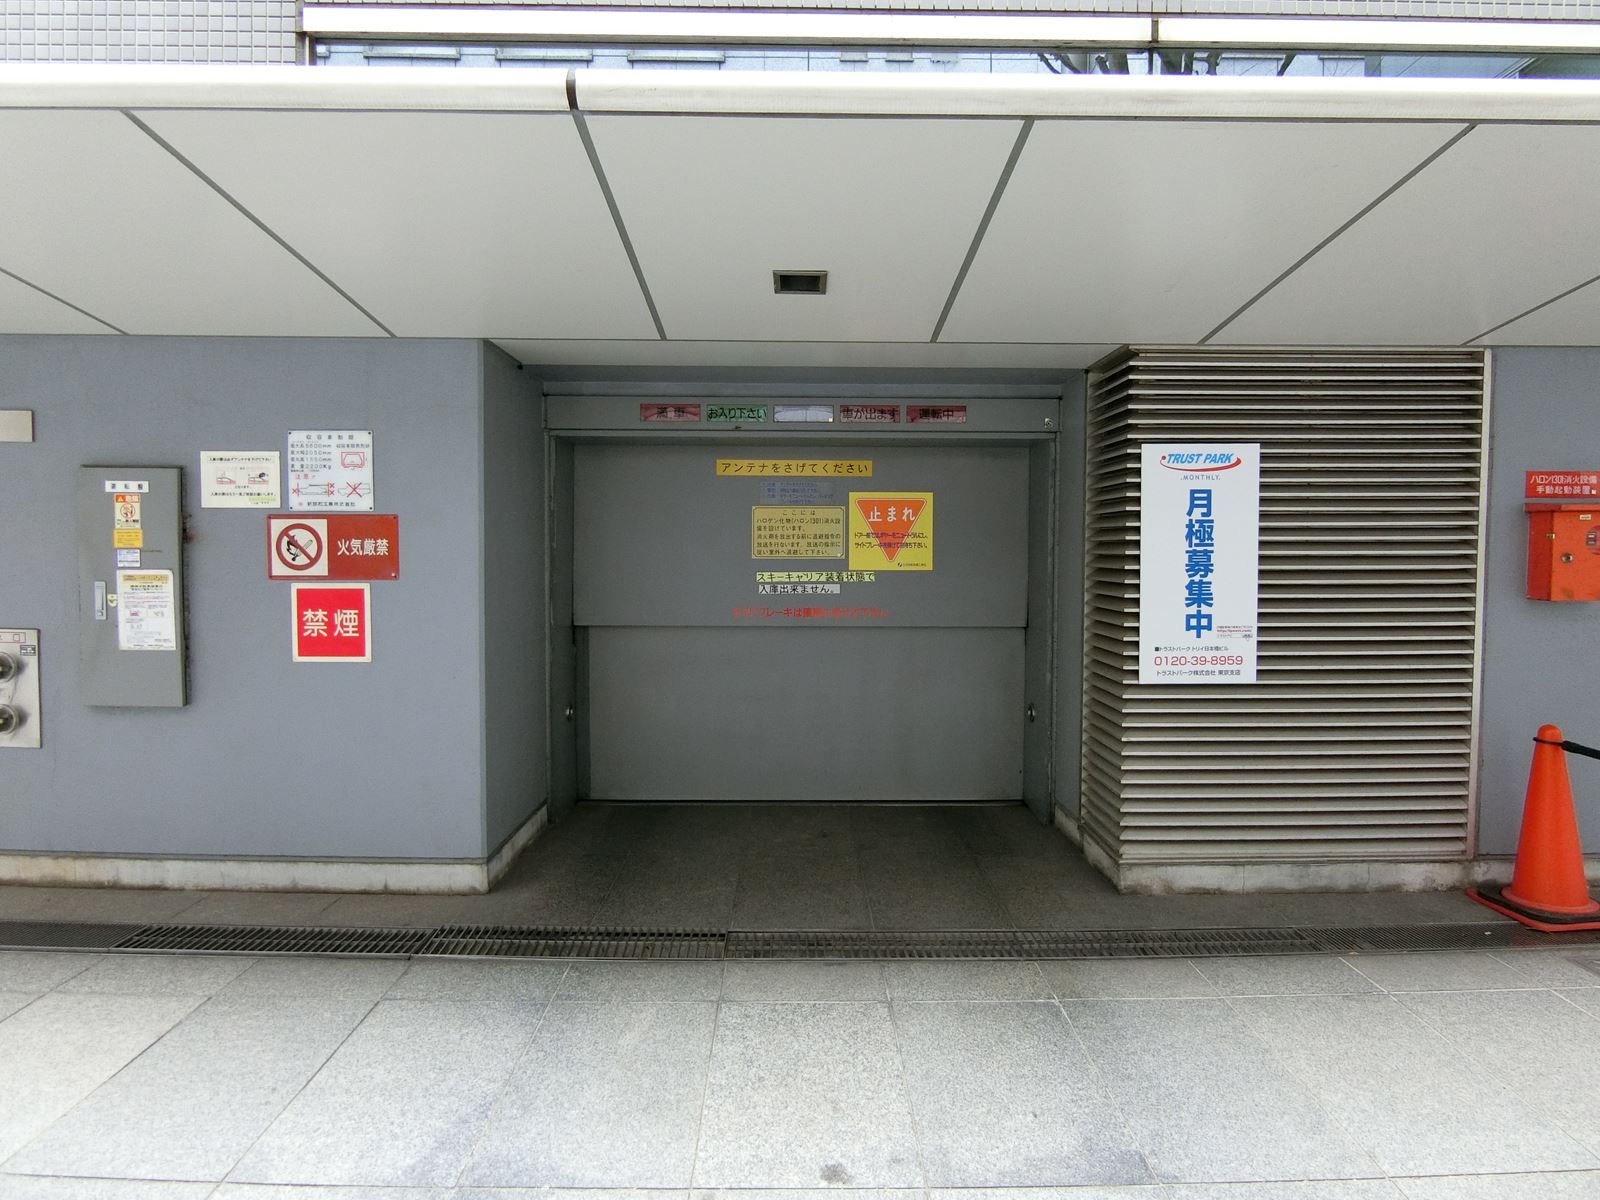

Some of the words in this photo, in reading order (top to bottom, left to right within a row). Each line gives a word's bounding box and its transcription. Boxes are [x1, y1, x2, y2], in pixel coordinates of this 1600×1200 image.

[708, 407, 767, 419] お入り下さい
[842, 408, 898, 421] 車が出ます
[919, 408, 954, 420] 運転中
[1167, 453, 1203, 464] TRUST
[1203, 453, 1234, 464] PARK
[721, 462, 868, 474] アンテナをさげてください
[868, 505, 916, 522] 止まれ
[337, 538, 389, 556] 火気厳禁
[1185, 489, 1214, 638] 月極募集中
[757, 572, 875, 583] スキーキャリア装着状態で
[759, 584, 834, 594] 入庫出来ません。
[302, 608, 360, 637] 禁煙
[1154, 656, 1243, 666] 0120-39-8959
